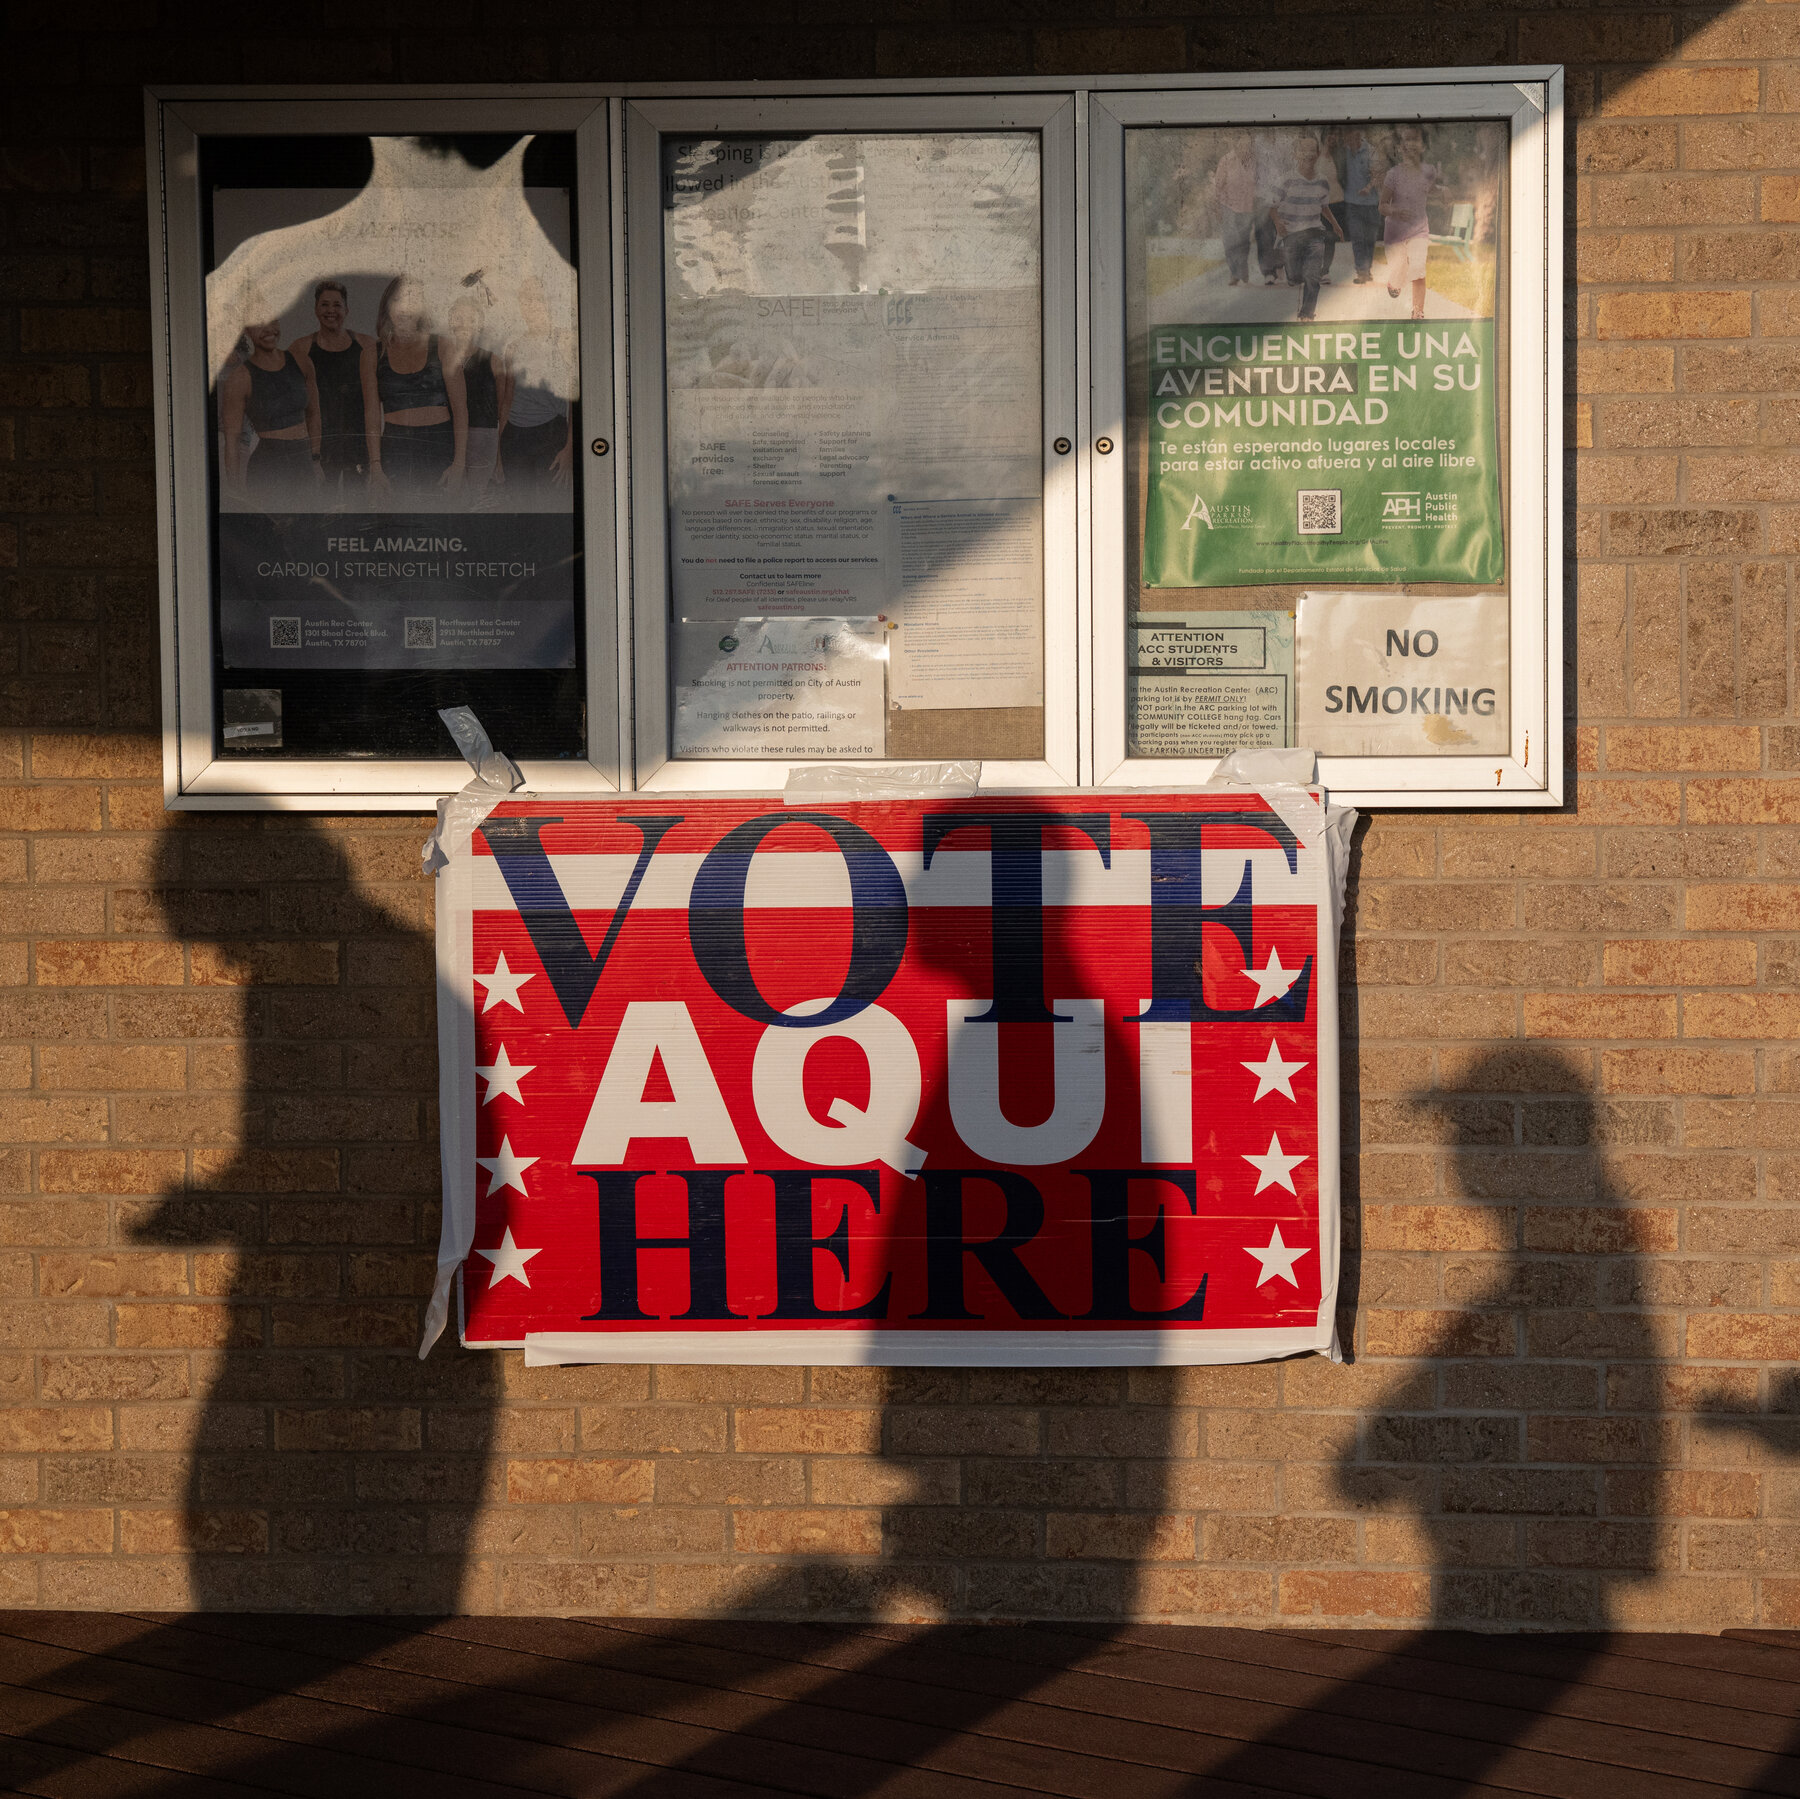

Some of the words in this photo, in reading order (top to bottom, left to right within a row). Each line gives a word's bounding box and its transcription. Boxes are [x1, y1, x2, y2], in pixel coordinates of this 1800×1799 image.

[757, 299, 816, 317] SAFE
[1156, 332, 1381, 364] ENCUENTRE
[1398, 332, 1479, 359] UNA
[1155, 366, 1354, 396] AVENTURA
[1369, 366, 1416, 391] EN
[1433, 364, 1481, 391] SU
[1157, 398, 1389, 429] COMUNIDAD
[1159, 441, 1176, 455] Te
[1183, 439, 1227, 454] están
[1235, 438, 1322, 456] esperando
[1328, 438, 1389, 454] lugares
[1395, 436, 1455, 451] locales
[691, 455, 734, 464] provides
[1160, 460, 1198, 474] para
[1205, 457, 1243, 471] estar
[1250, 455, 1301, 470] activo
[1307, 455, 1361, 469] afuera
[1366, 457, 1374, 471] y
[1382, 454, 1397, 468] al
[1403, 454, 1433, 468] aire
[1439, 452, 1476, 467] libre
[1383, 498, 1420, 515] APH
[1425, 513, 1458, 521] Health
[327, 538, 369, 552] FEEL
[373, 538, 468, 552] AMAZING.
[257, 562, 330, 577] CARDIO
[344, 562, 440, 577] STRENGTH
[455, 562, 536, 577] STRETCH
[305, 639, 332, 647] Austin,
[334, 639, 344, 647] TX
[345, 639, 367, 647] 78701
[1151, 633, 1224, 641] ATTENTION
[1386, 629, 1439, 658] NO
[1138, 644, 1164, 654] ACC
[1169, 644, 1238, 654] STUDENTS
[726, 662, 778, 671] ATTENTION
[781, 662, 827, 671] PATRONS:
[1152, 657, 1161, 666] &
[1164, 657, 1223, 666] VISITORS
[692, 679, 726, 688] Smoking
[729, 679, 735, 687] is
[753, 679, 793, 689] permitted
[808, 679, 823, 688] City
[825, 679, 834, 687] of
[836, 679, 860, 687] Austin
[1256, 686, 1278, 696] (ARC)
[758, 692, 795, 702] property.
[1324, 685, 1496, 716] SMOKING
[696, 711, 730, 720] Hanging
[791, 712, 814, 720] patio,
[816, 711, 846, 720] railings
[723, 725, 761, 733] walkways
[788, 725, 830, 733] permitted.
[477, 812, 1317, 1029] VOTE
[571, 996, 1194, 1180] AQUI
[576, 1168, 1209, 1322] HERE
